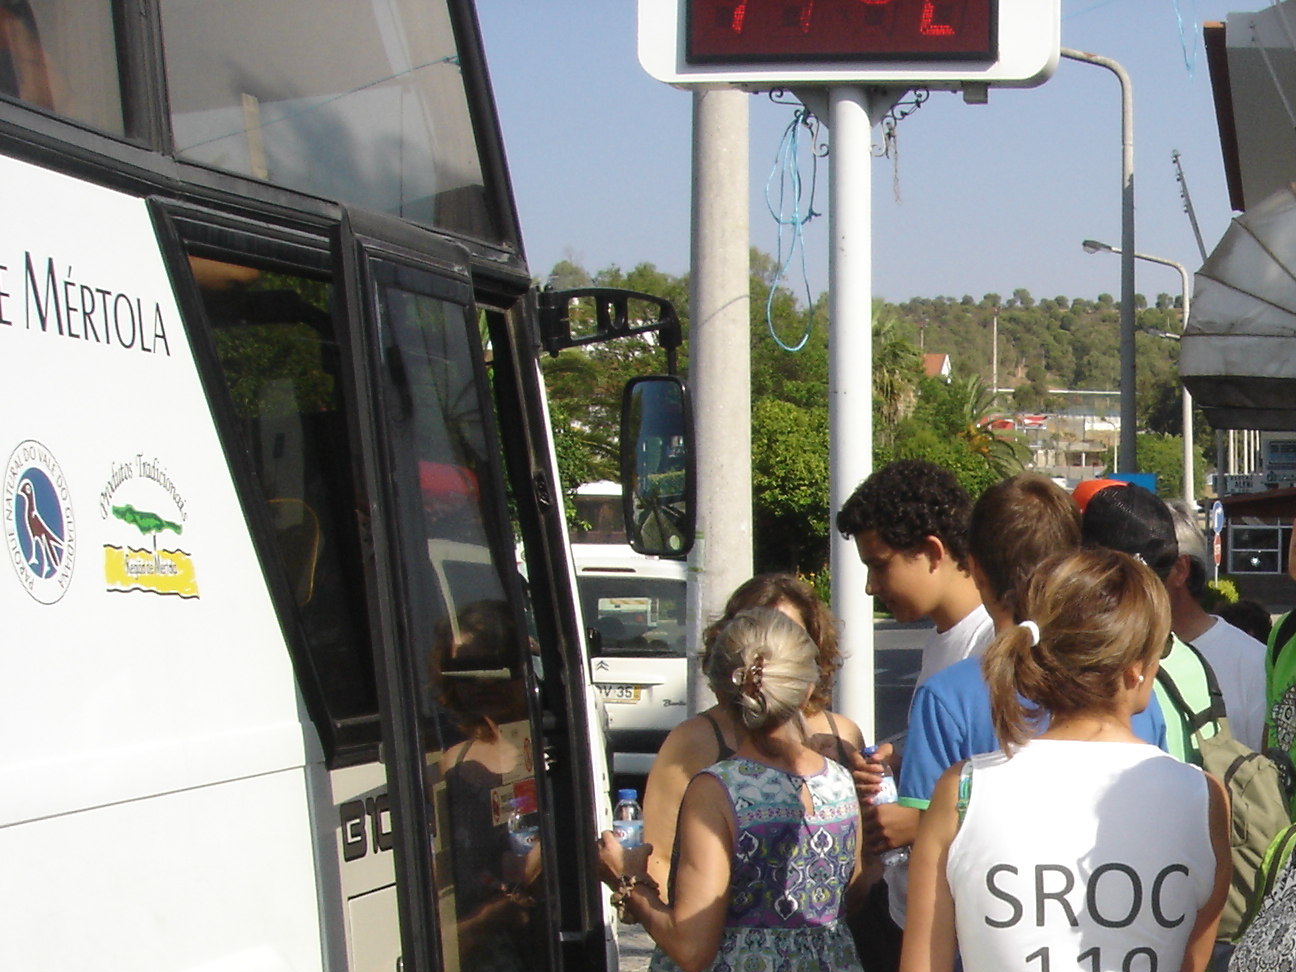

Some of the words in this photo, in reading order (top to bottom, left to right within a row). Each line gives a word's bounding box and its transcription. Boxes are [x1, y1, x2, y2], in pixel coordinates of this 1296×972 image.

[24, 251, 171, 357] MÉRTOLA
[23, 446, 37, 462] DO
[38, 450, 57, 475] VALE
[5, 455, 24, 521] NATURAL
[56, 474, 68, 501] DO
[57, 507, 75, 590] GUADIANA
[984, 862, 1189, 929] SROC
